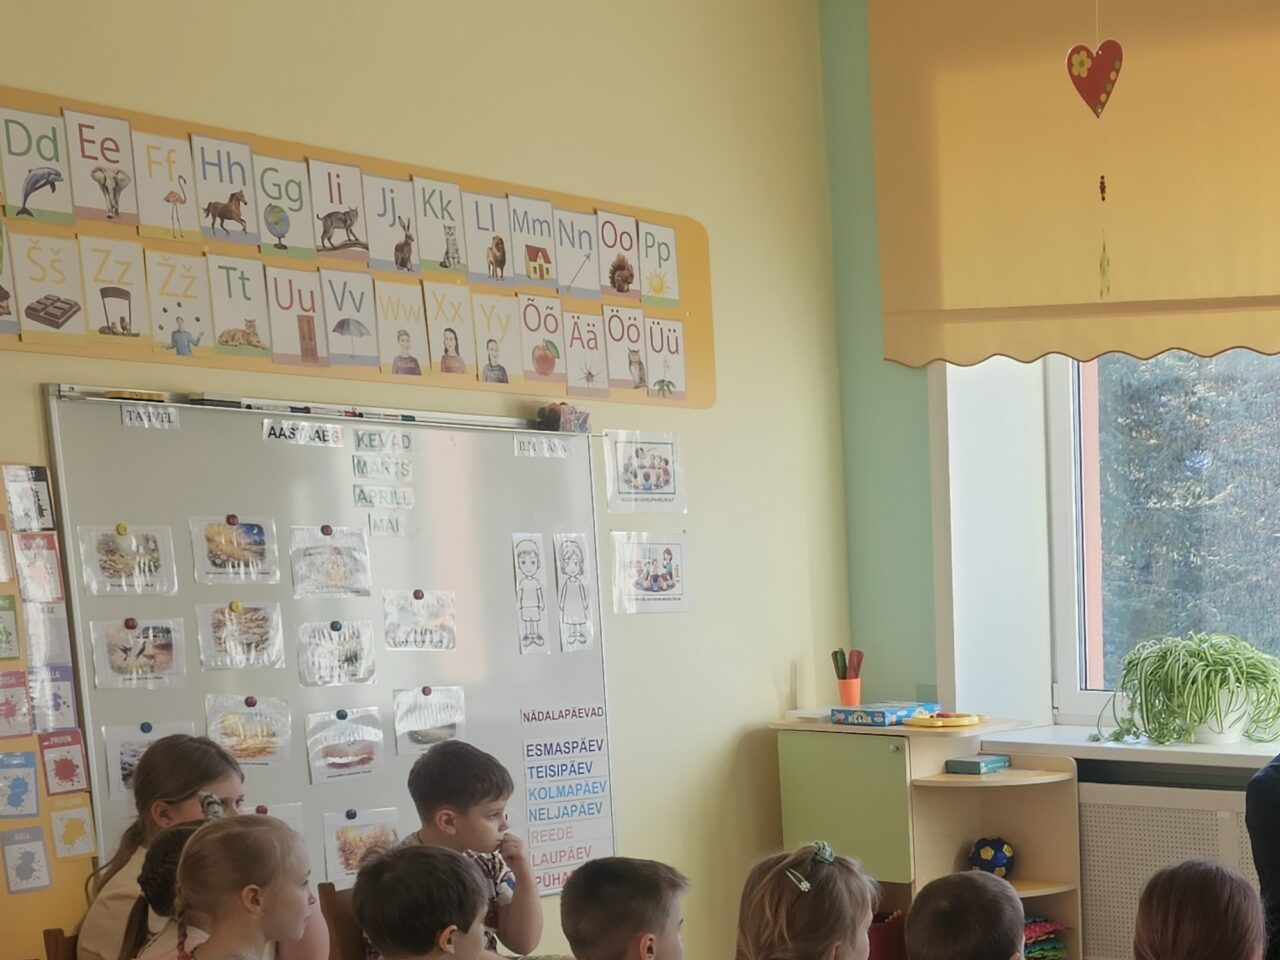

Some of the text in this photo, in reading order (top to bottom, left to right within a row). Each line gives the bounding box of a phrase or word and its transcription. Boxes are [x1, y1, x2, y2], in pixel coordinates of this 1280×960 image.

[4, 118, 59, 162] Dd
[77, 123, 120, 164] Ee
[146, 144, 177, 182] Ff
[200, 146, 247, 186] Hh
[260, 167, 303, 212] Gg
[422, 187, 454, 221] Kk
[377, 187, 396, 228] Jj
[475, 201, 495, 232] Ll
[512, 209, 551, 238] Mm
[558, 218, 593, 250] Nn
[601, 220, 633, 251] Oo
[644, 232, 670, 268] Pp
[26, 238, 66, 284] Šš
[92, 249, 134, 286] Zz
[158, 256, 198, 299] Žž
[218, 266, 251, 301] Tt
[274, 277, 316, 313] Uu
[329, 279, 364, 313] Vv
[379, 295, 421, 323] Ww
[432, 291, 464, 323] Xx
[479, 304, 510, 341] Yy
[522, 296, 558, 334] Õõ
[570, 316, 598, 351] Ää
[608, 307, 639, 344] Öö
[650, 321, 679, 354] Üü
[523, 706, 604, 723] NÄDALAPÄEVAD
[526, 738, 604, 758] ESMASPÄEV
[528, 760, 593, 780] TEISIPÄEV
[528, 780, 607, 802] KOLMAPÄEV
[529, 801, 603, 822] NELJAPÄEV
[531, 826, 573, 844] REEDE
[532, 845, 592, 868] LAUPÄEV
[536, 871, 573, 889] PÜHA
